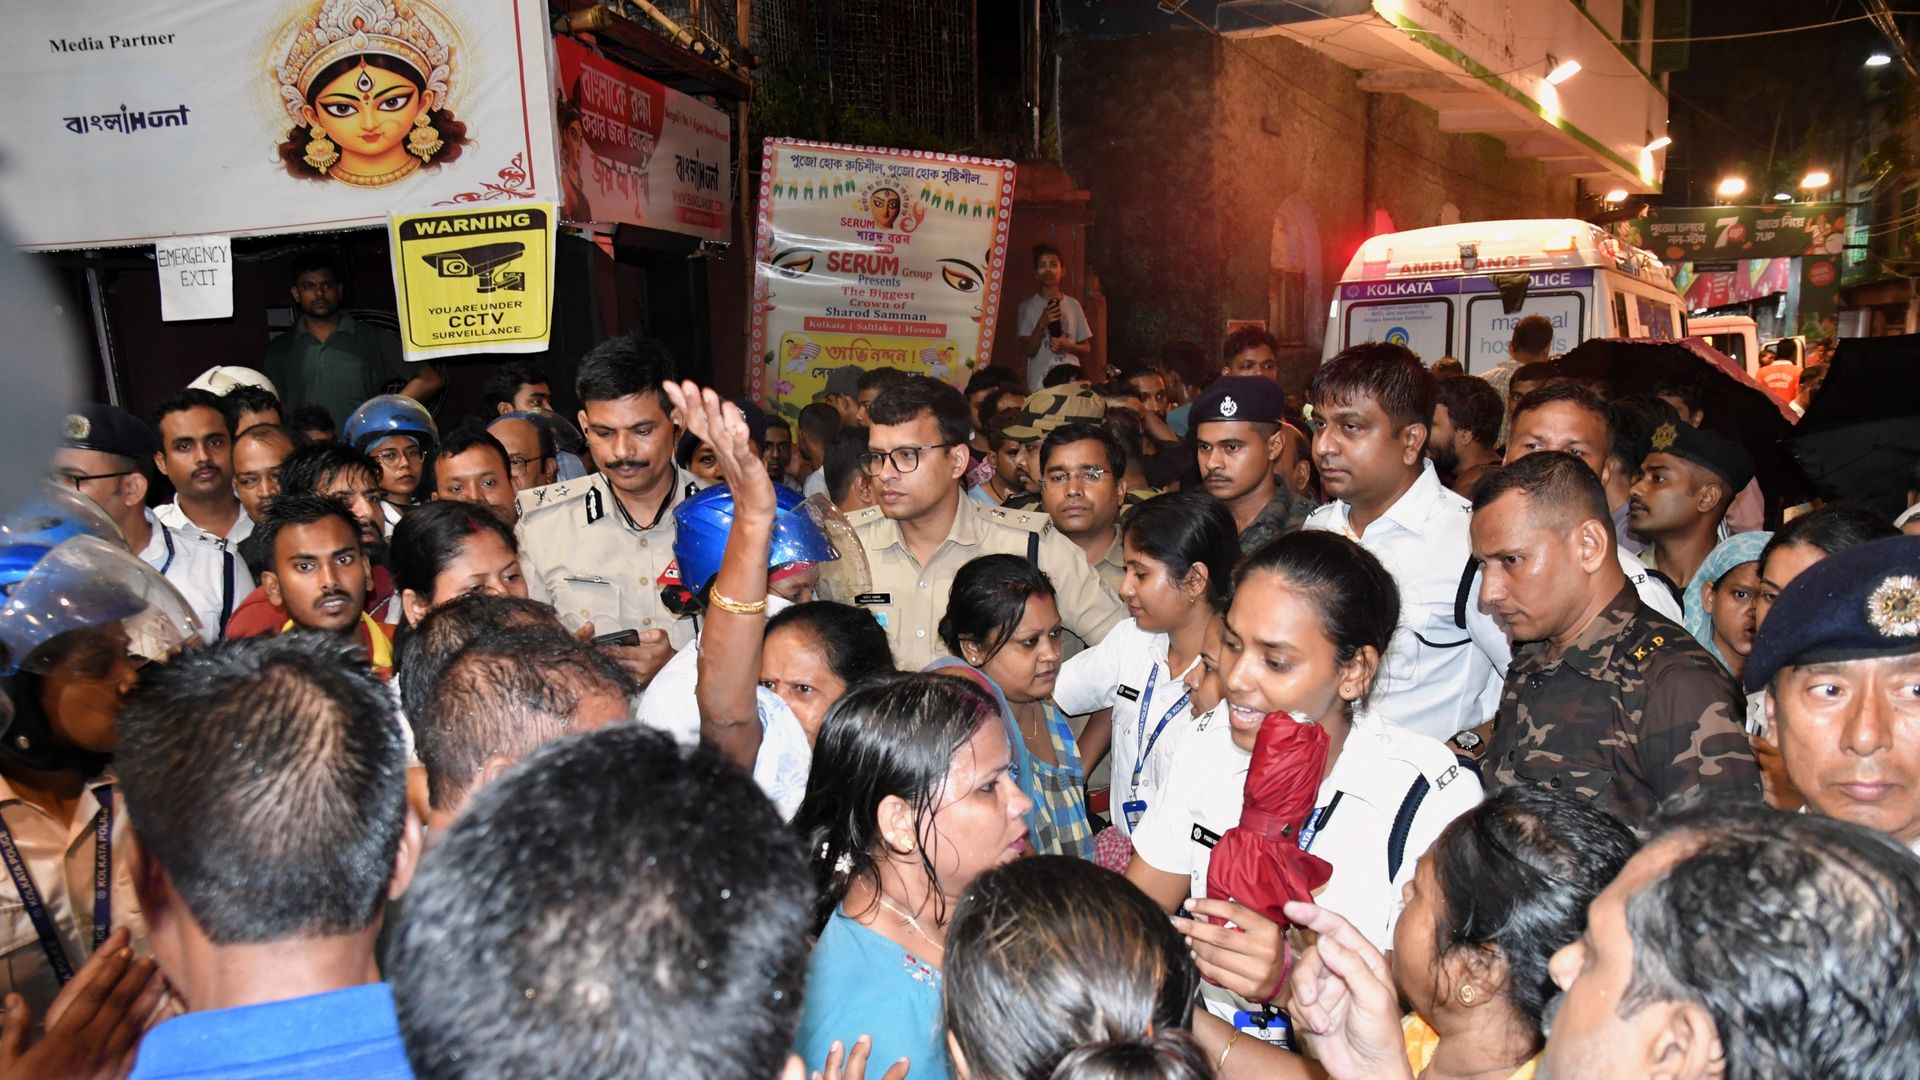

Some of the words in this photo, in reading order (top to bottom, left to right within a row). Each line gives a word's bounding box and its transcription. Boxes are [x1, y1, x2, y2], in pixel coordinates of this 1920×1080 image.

[49, 37, 104, 53] Media
[109, 33, 175, 49] Partner
[790, 154, 817, 168] পুজো
[819, 158, 843, 170] হোক
[887, 164, 914, 178] পুজো
[916, 168, 939, 180] হোক
[415, 213, 530, 235] WARNING
[840, 217, 875, 229] SERUM
[1714, 216, 1739, 249] 7
[1755, 232, 1776, 242] 7UP
[158, 245, 227, 267] EMERGENCY
[827, 251, 899, 276] SERUM
[902, 268, 933, 280] Group
[1400, 255, 1531, 275] AMBUANCE
[180, 268, 218, 286] EXIT
[858, 274, 901, 287] Presents
[842, 286, 865, 297] The
[869, 288, 916, 300] Biggest
[1367, 282, 1433, 296] KOLKATA
[429, 306, 451, 315] YOU
[454, 304, 478, 313] ARE
[480, 301, 522, 310] UNDER
[849, 298, 890, 309] Crown
[893, 301, 907, 309] of
[449, 312, 504, 328] CCTV
[825, 307, 870, 318] Sharod
[873, 310, 927, 321] Samman
[432, 326, 521, 339] SURVEILLANCE
[809, 320, 845, 329] Kolkata
[905, 325, 941, 335] Howrah
[97, 843, 108, 887] KOLKATA
[13, 863, 38, 906] KOLKATA
